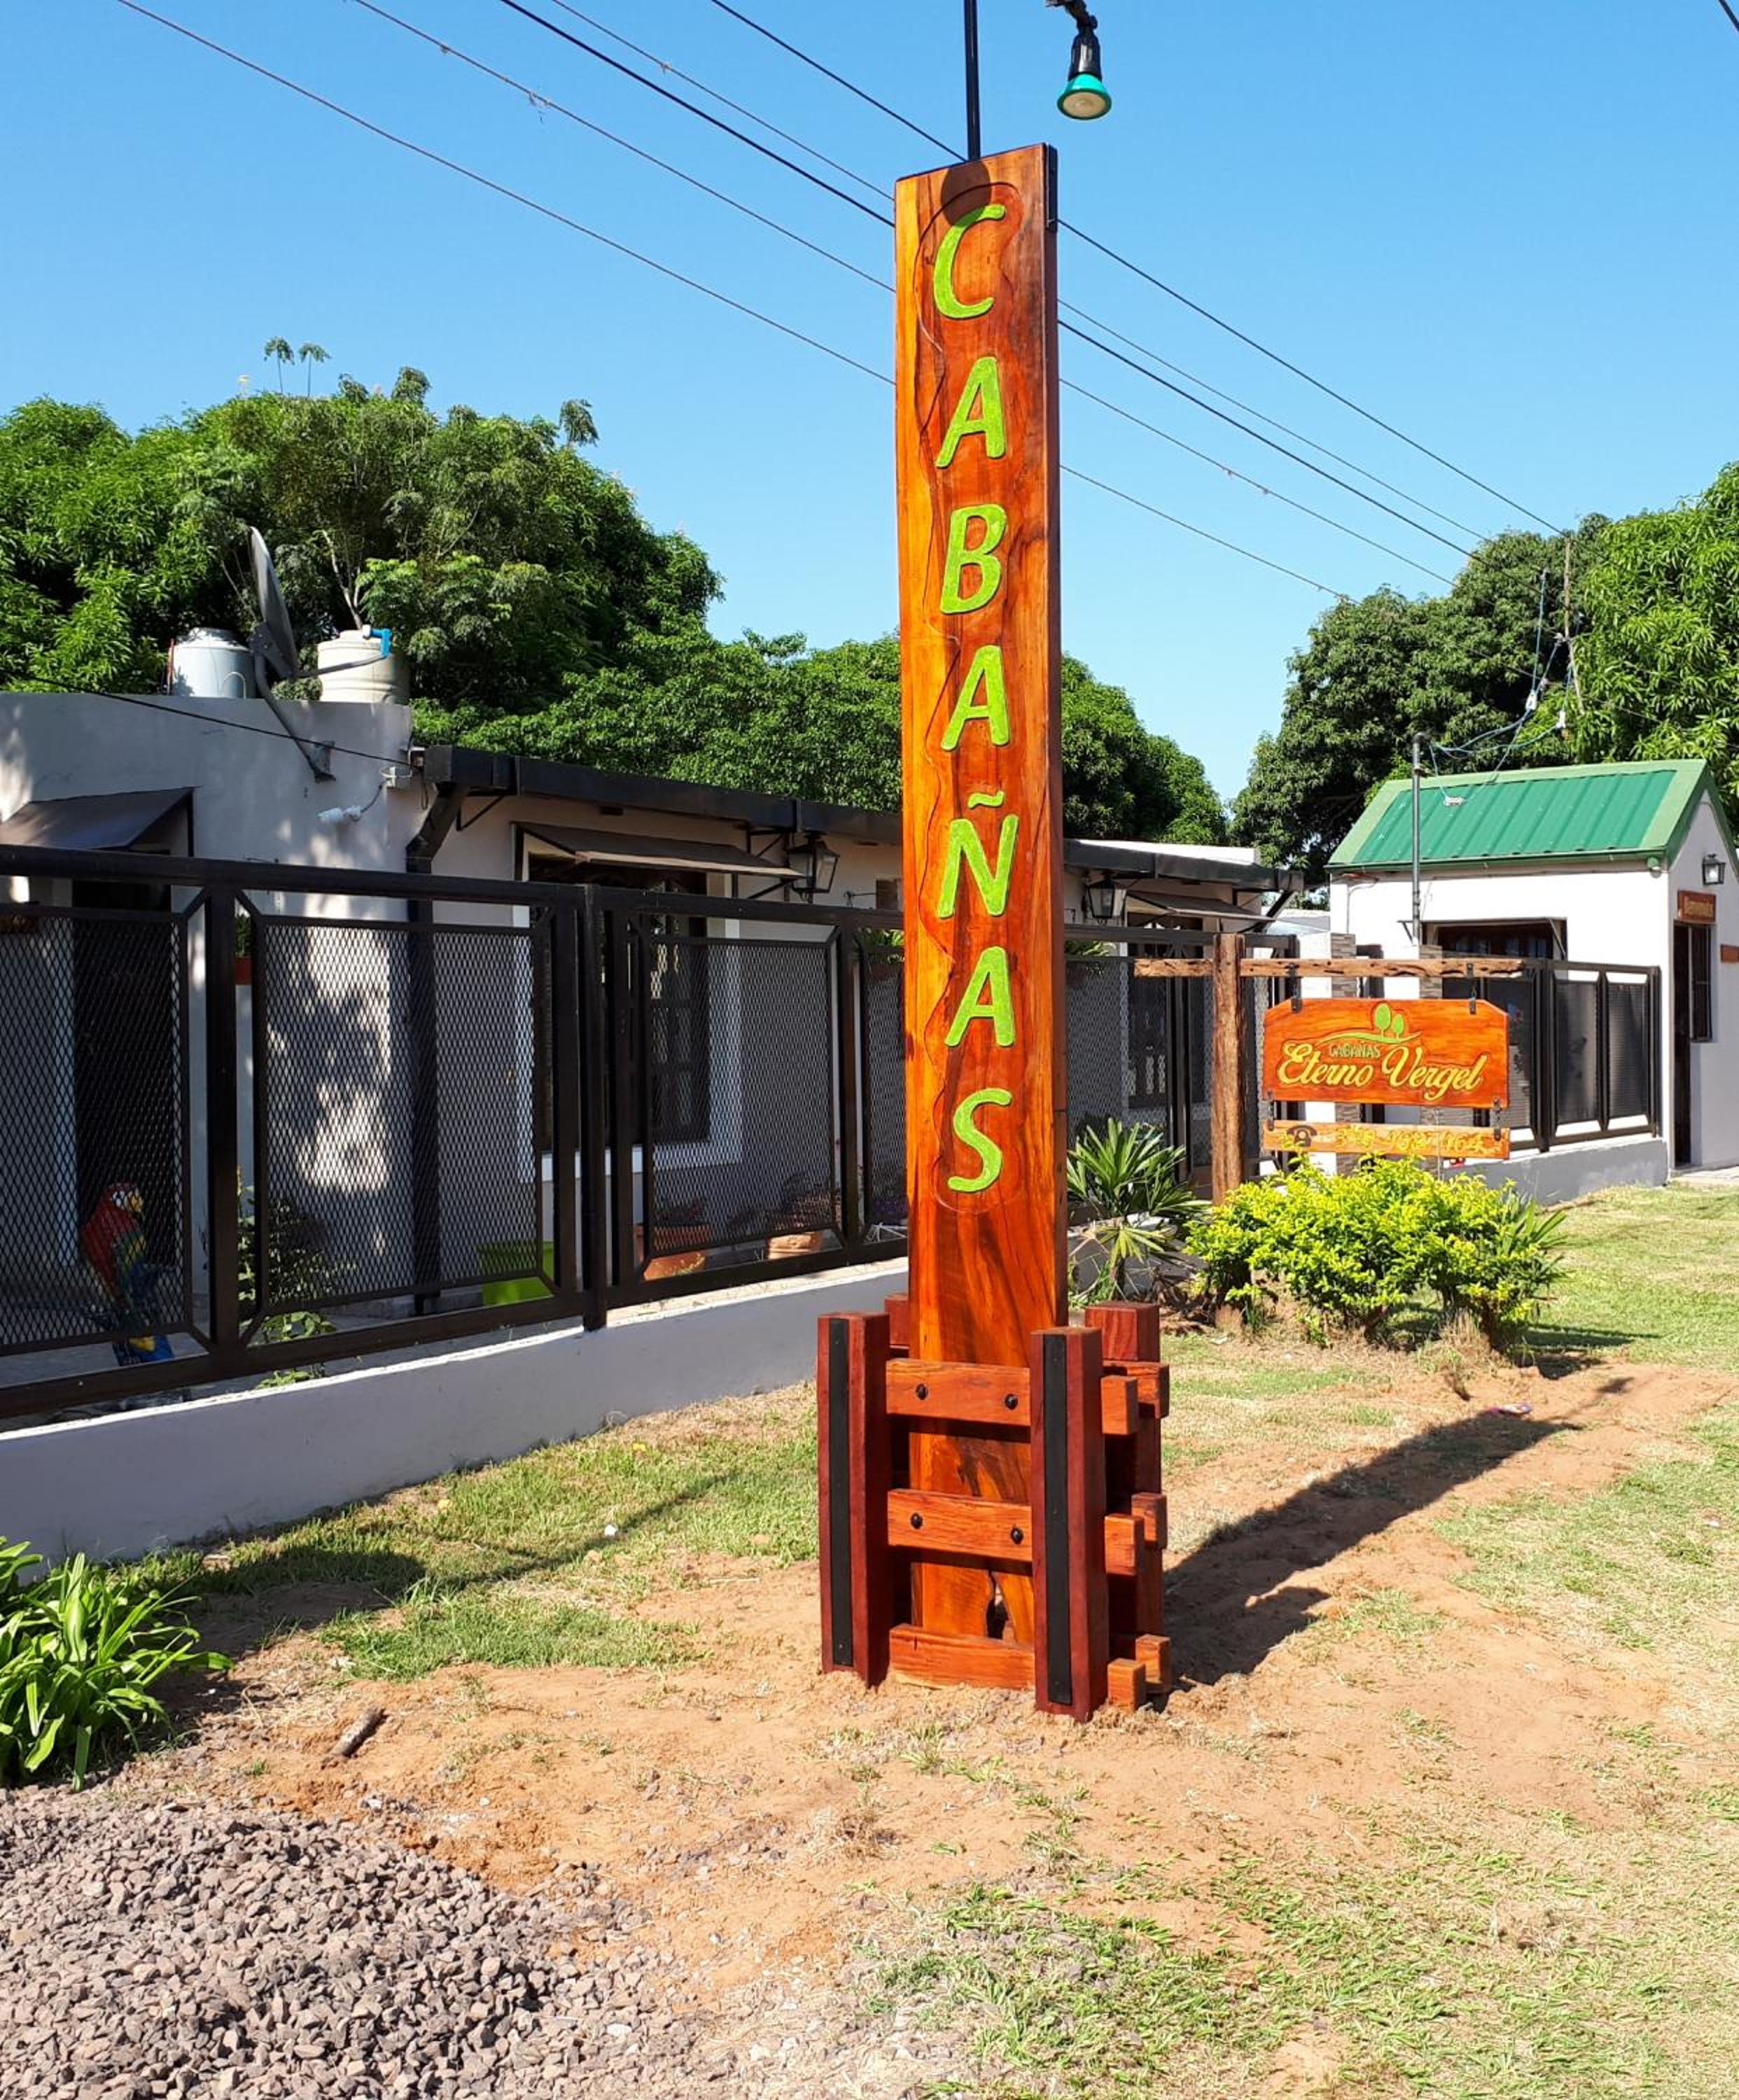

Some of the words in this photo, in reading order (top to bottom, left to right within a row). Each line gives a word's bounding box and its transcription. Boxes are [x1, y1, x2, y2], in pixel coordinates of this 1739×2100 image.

[933, 203, 1019, 1193] CABAÑAS
[1276, 1043, 1374, 1088] Eterno
[1381, 1046, 1489, 1101] Vergel
